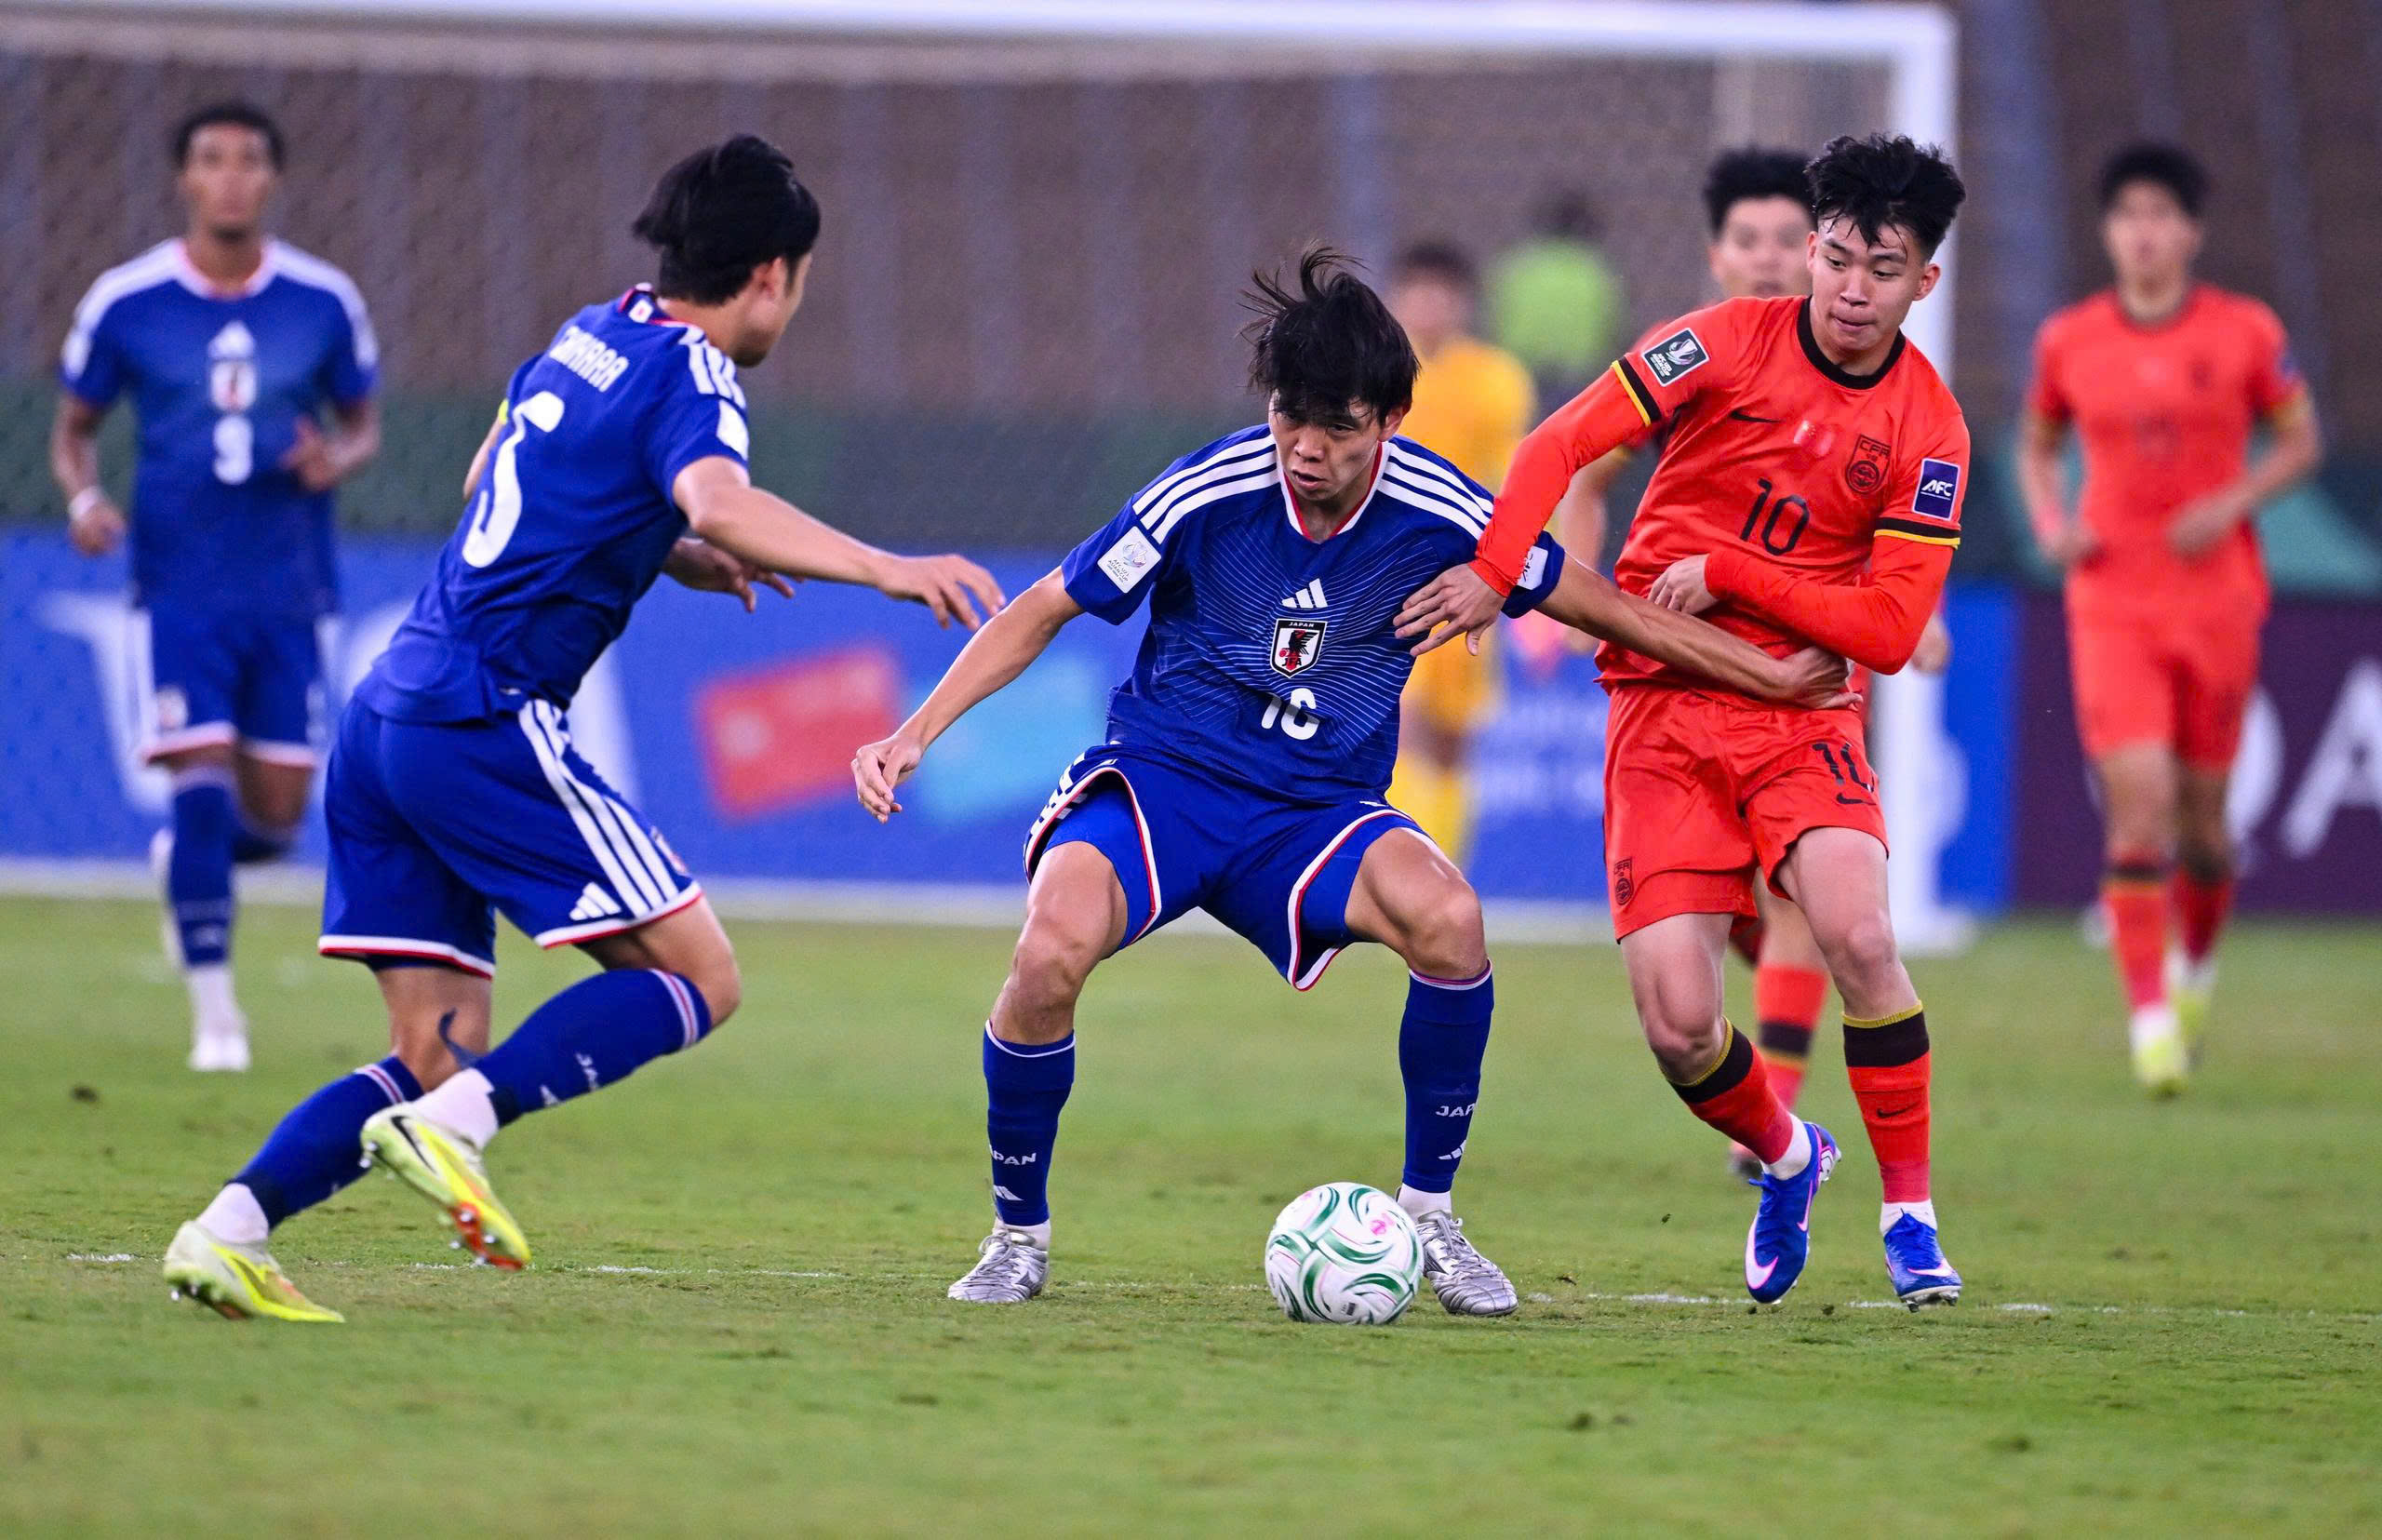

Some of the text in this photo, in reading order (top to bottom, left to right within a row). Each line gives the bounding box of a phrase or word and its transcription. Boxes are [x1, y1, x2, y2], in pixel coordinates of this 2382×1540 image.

[213, 416, 254, 485] 9
[1921, 479, 1954, 497] AFC
[1739, 476, 1810, 556] 10
[1281, 657, 1303, 667] JFA
[1261, 688, 1320, 741] 16
[1435, 1103, 1476, 1118] JAP
